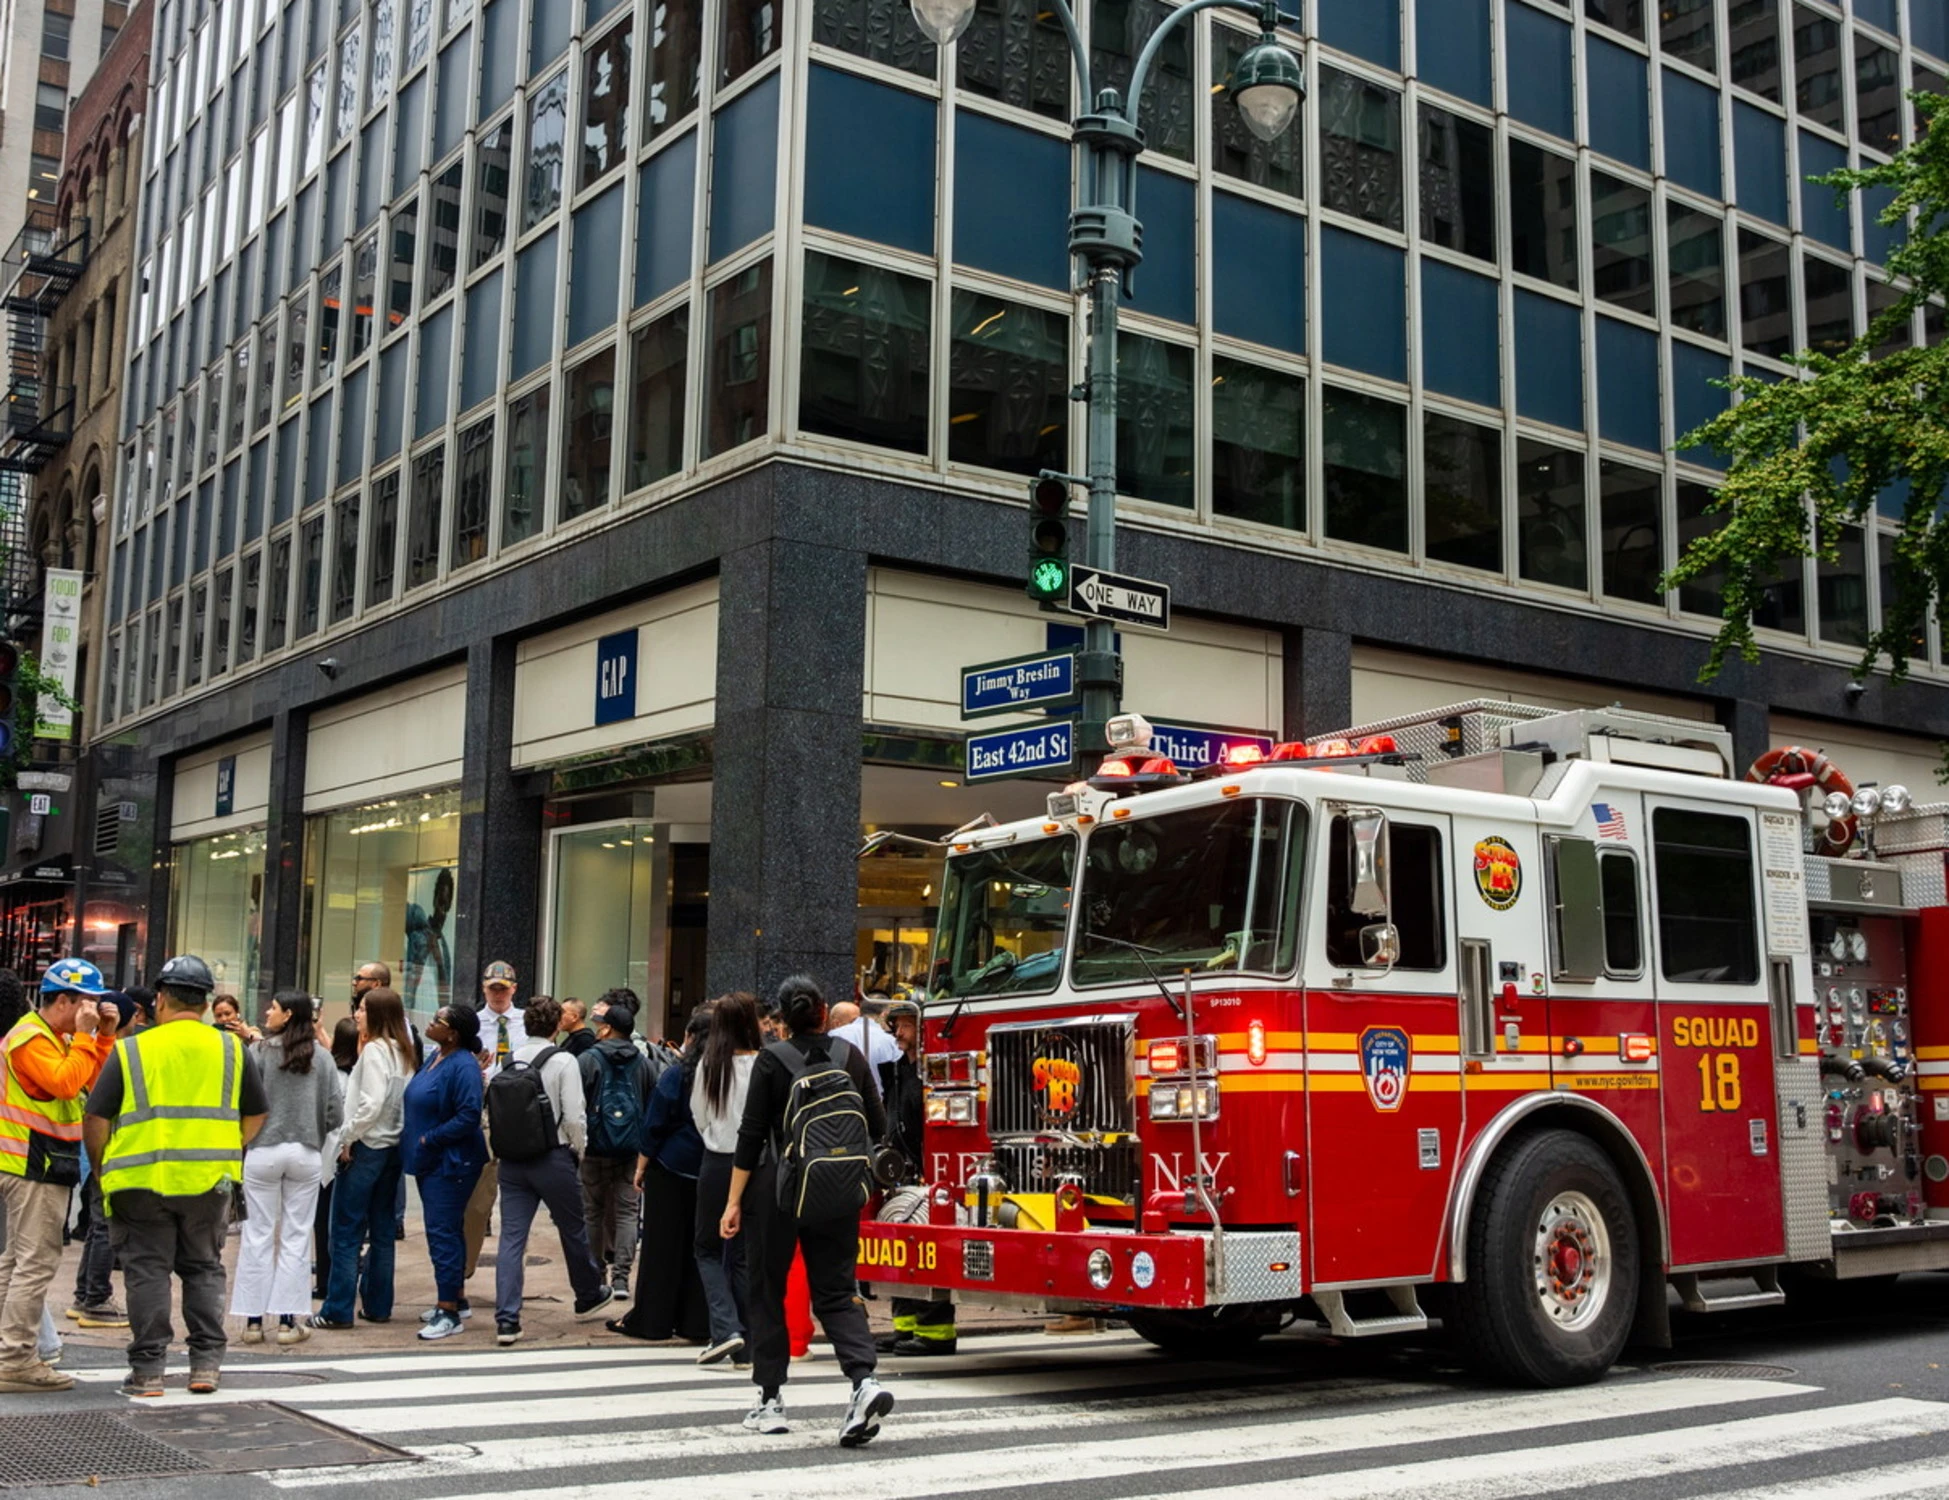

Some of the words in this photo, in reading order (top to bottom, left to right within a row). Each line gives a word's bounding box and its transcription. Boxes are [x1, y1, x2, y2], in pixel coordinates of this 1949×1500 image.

[51, 579, 78, 597] FOOD
[1086, 583, 1114, 605] ONE
[1127, 592, 1156, 614] WAY
[52, 625, 71, 643] FOR
[601, 655, 627, 699] GAP
[975, 675, 1014, 696] Jimmy
[1016, 663, 1060, 684] Breslin
[1009, 687, 1030, 700] Way
[972, 746, 1005, 770] East
[1008, 736, 1046, 764] 42nd
[1050, 733, 1067, 758] St
[1151, 735, 1210, 764] Third
[33, 796, 46, 811] EAT
[1490, 862, 1514, 890] 18
[1375, 1040, 1387, 1048] CITY
[1673, 1016, 1759, 1048] SQUAD
[1048, 1079, 1074, 1112] 18
[1575, 1073, 1653, 1089] www.nyc.gov/fdny
[1698, 1052, 1742, 1113] 18
[856, 1237, 907, 1268] QUAD
[917, 1241, 937, 1270] 18
